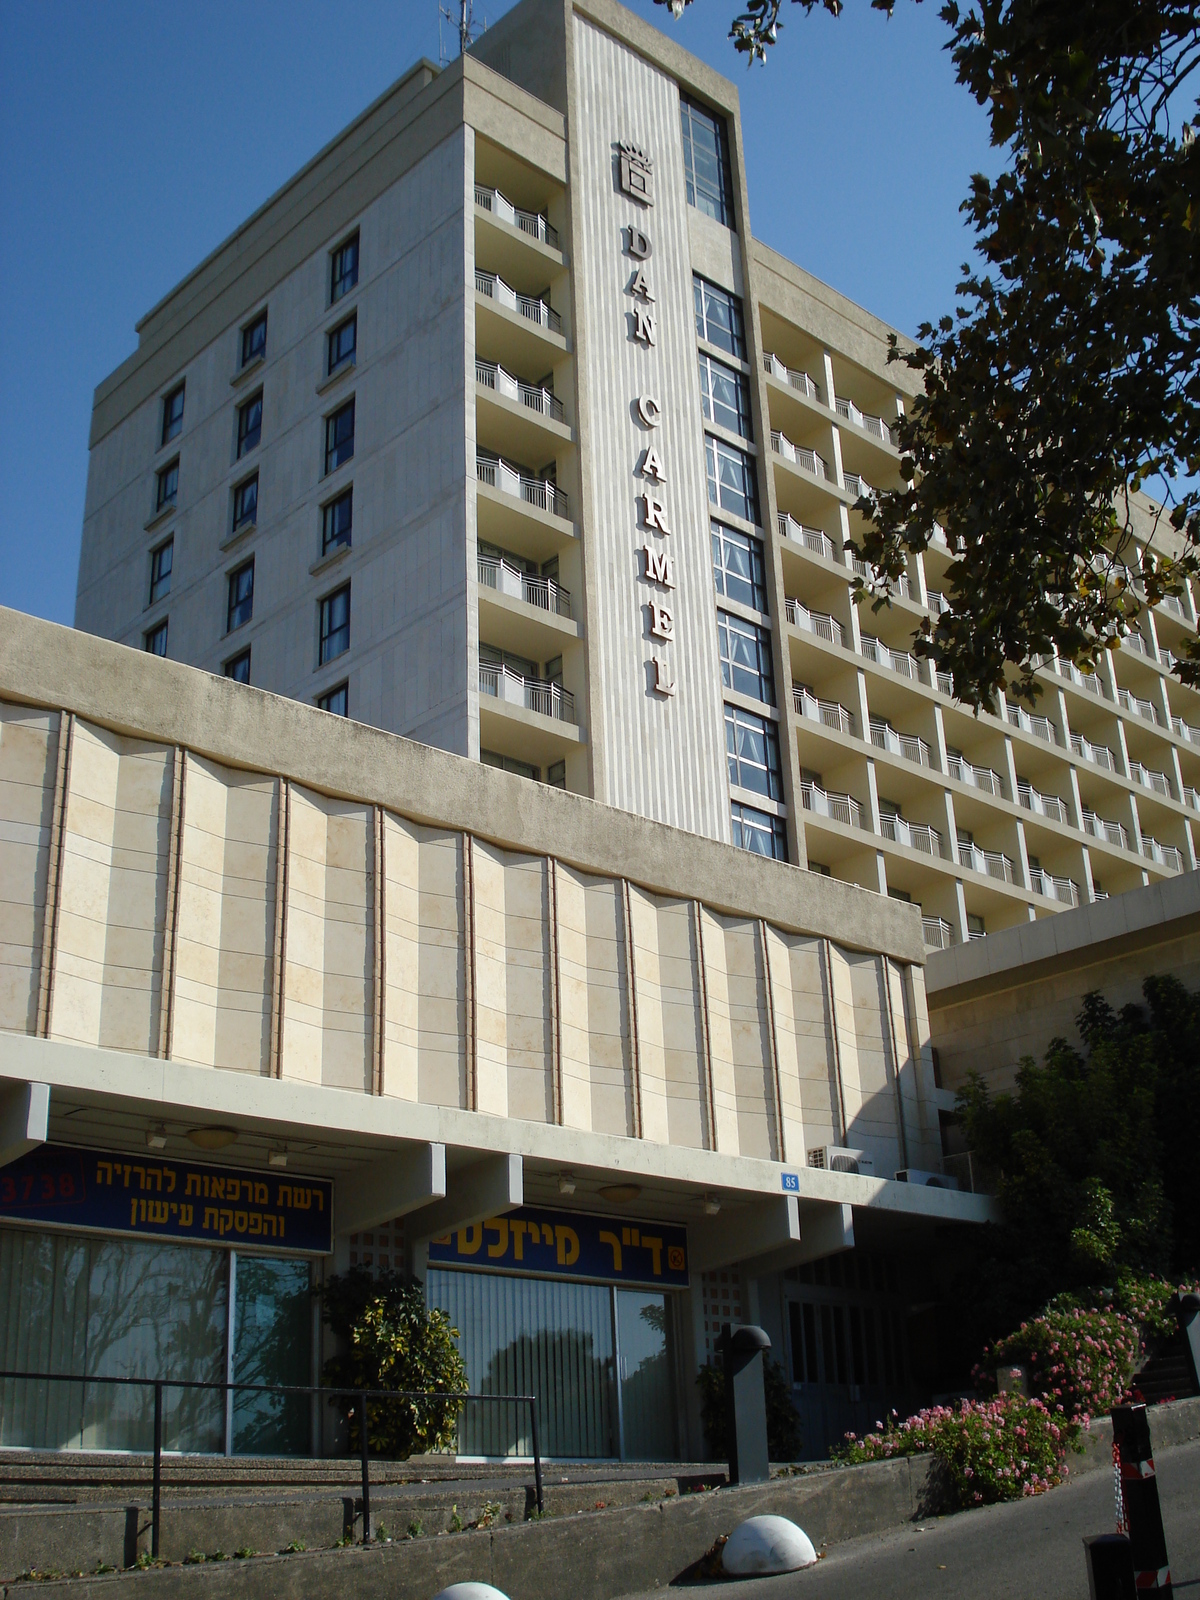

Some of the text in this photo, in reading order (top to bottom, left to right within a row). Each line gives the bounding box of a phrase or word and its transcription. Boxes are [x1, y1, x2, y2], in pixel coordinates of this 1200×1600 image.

[628, 224, 676, 697] DAN CARMEL
[96, 1161, 177, 1193] להרזיה
[185, 1173, 269, 1205] מרפאות
[785, 1176, 796, 1188] 85
[277, 1185, 324, 1211] רשת
[131, 1198, 285, 1237] והפסקת עישון
